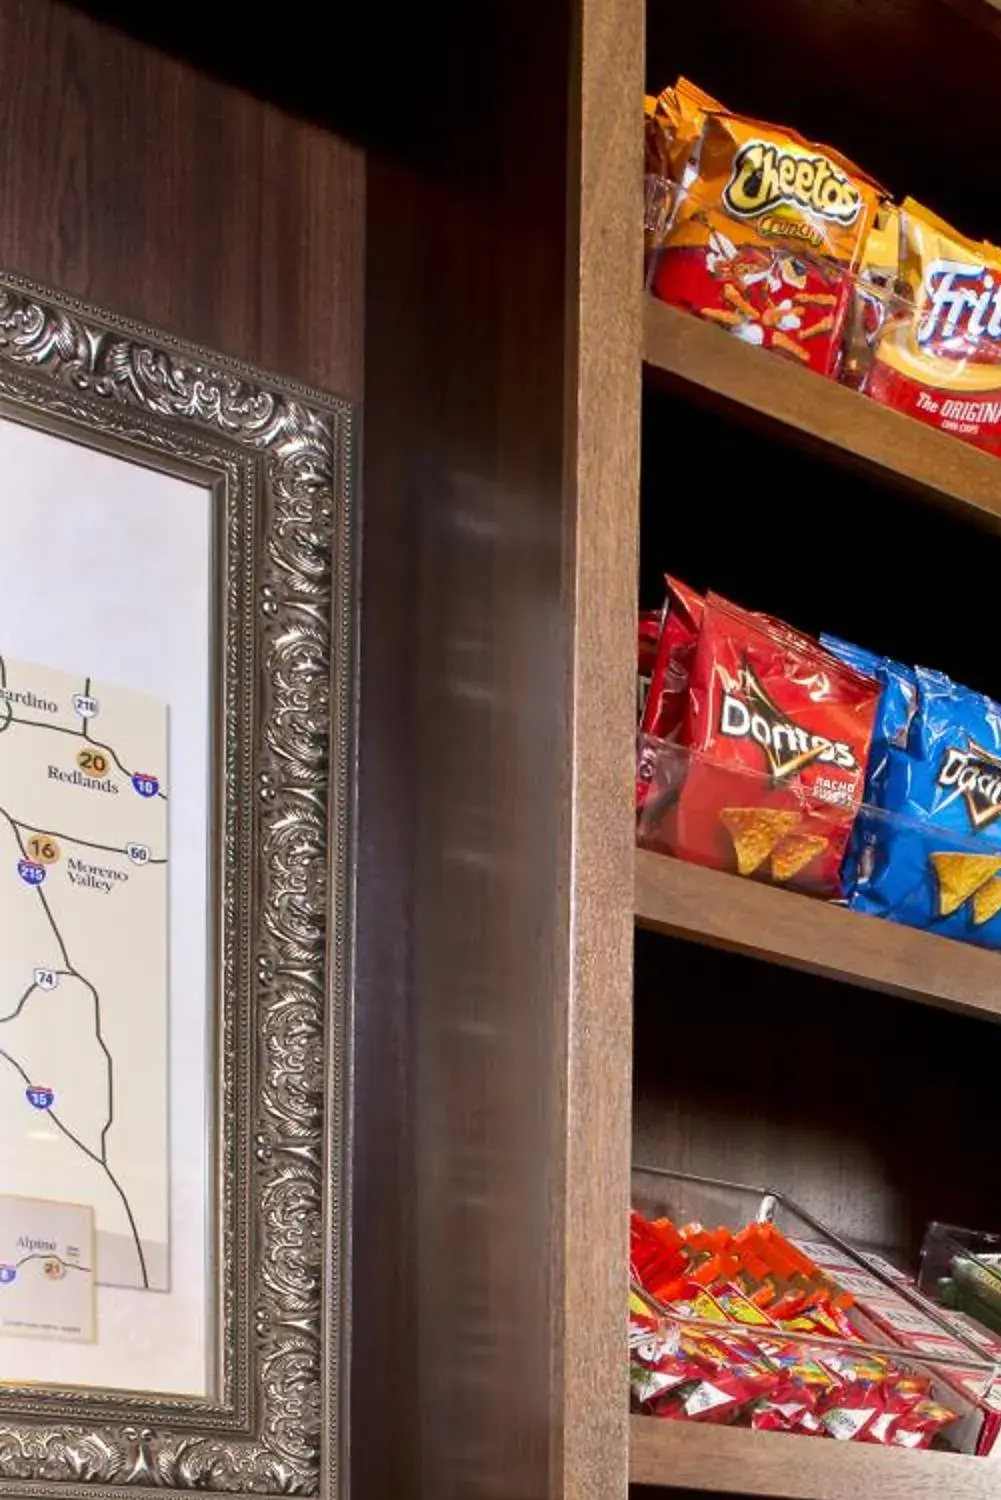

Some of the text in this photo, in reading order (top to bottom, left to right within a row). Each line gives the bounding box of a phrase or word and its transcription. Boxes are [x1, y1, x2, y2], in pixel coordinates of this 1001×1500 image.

[725, 141, 862, 221] Cheetos
[915, 392, 939, 413] The
[720, 694, 857, 767] Doritos
[79, 752, 107, 771] 20
[47, 765, 120, 794] Redlands
[31, 839, 56, 859] 16
[66, 857, 129, 882] Moreno
[66, 871, 114, 895] Valley
[39, 971, 53, 984] 74
